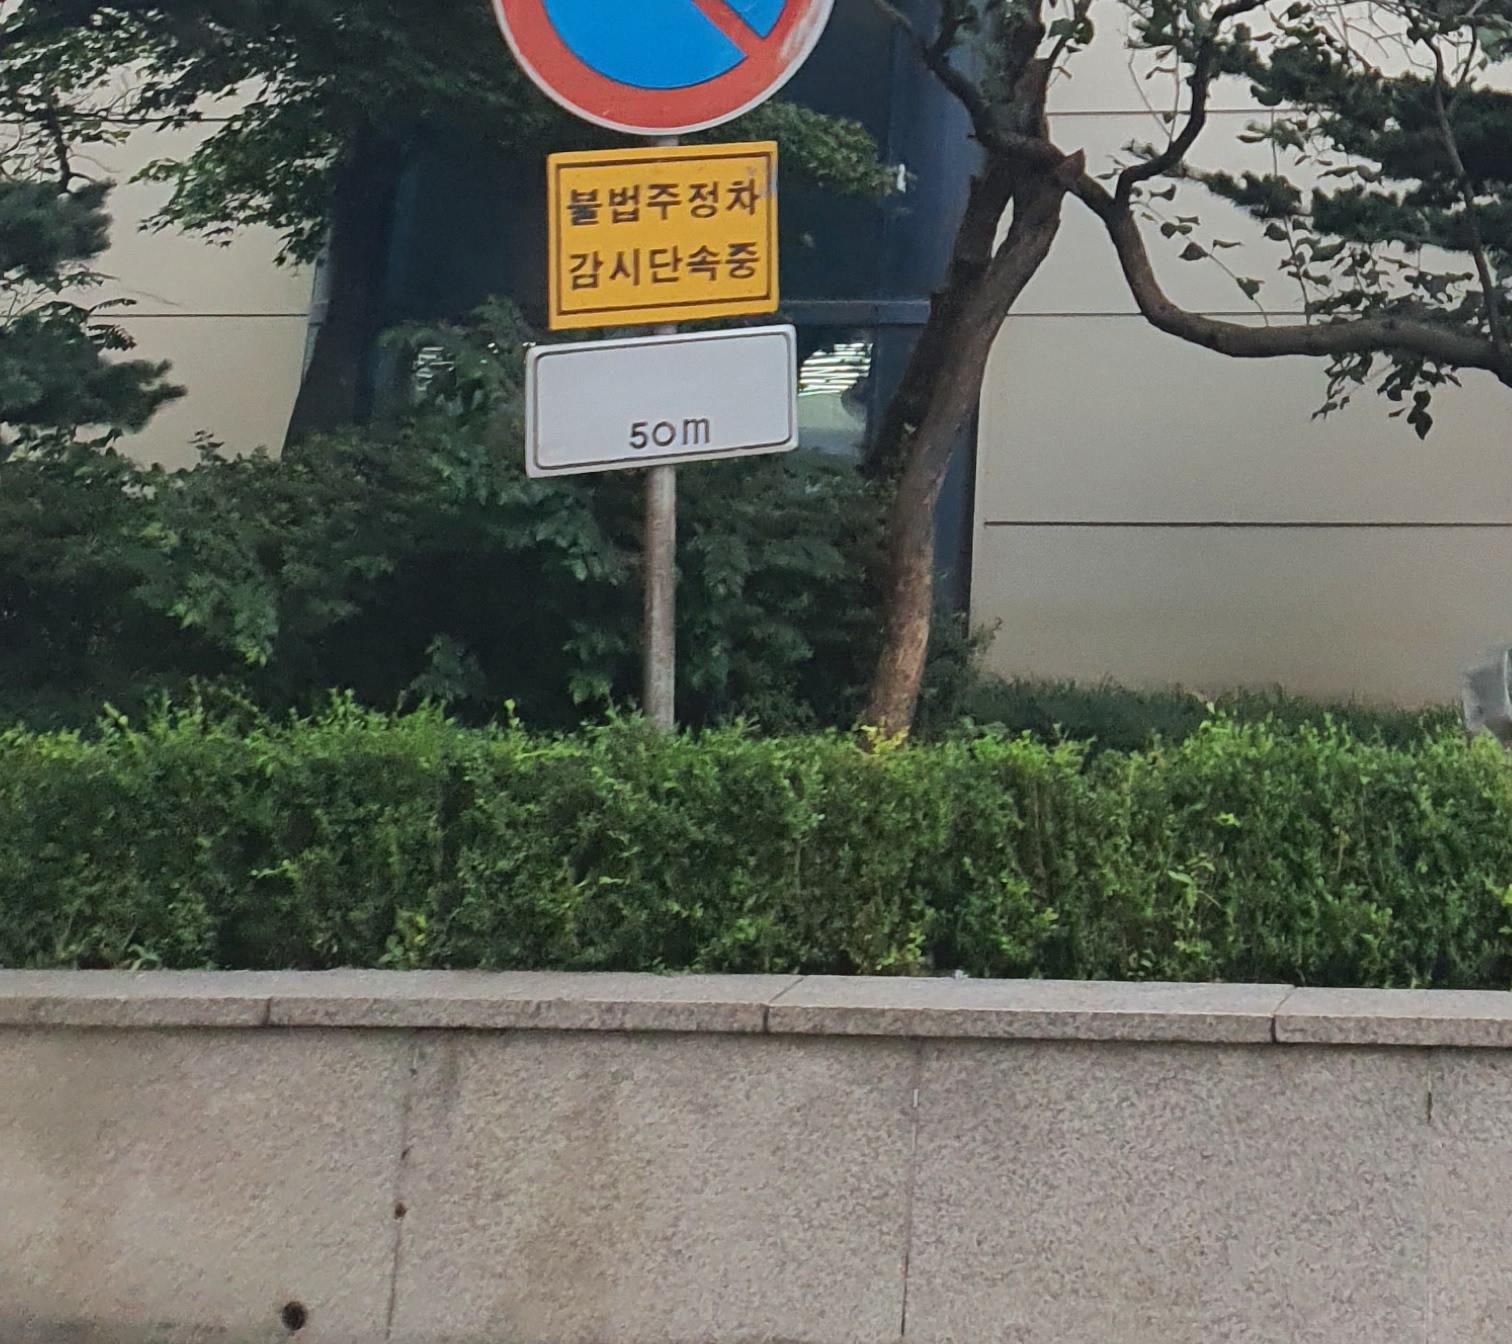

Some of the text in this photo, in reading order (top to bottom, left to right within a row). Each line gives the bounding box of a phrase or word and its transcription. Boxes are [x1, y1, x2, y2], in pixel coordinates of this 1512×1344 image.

[566, 178, 762, 227] 불법주정차
[568, 241, 761, 291] 감시단속중
[629, 417, 711, 450] 50m
